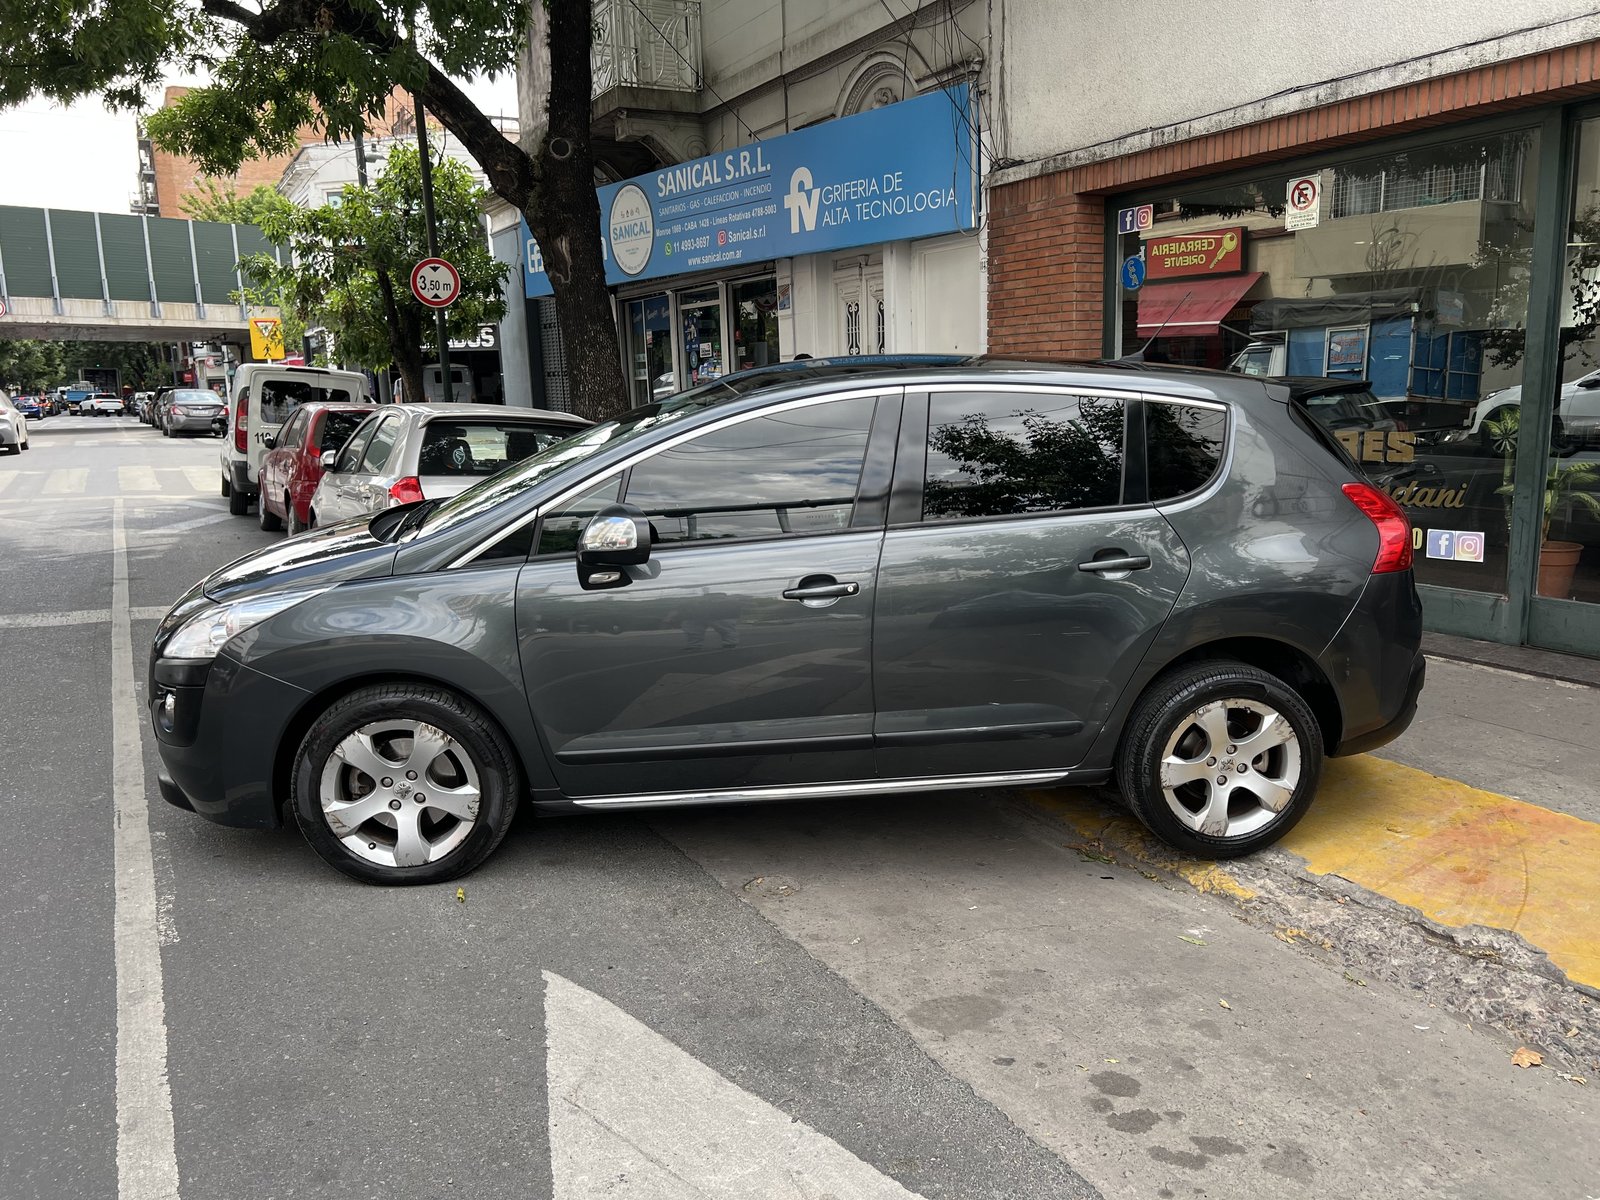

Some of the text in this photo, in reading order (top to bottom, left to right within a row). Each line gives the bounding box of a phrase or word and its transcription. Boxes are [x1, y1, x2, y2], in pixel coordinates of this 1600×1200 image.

[658, 147, 771, 197] SANICAL S.R.L.
[659, 202, 687, 217] SANITARIOS
[689, 199, 700, 210] GAS
[703, 190, 740, 206] CALEFACCION
[743, 182, 772, 196] INCENDIO
[821, 171, 903, 205] GRIFERIA DE
[822, 187, 958, 227] ALTA TECNOLOGIA
[612, 220, 651, 241] SANICAL
[656, 226, 671, 237] Monroe
[684, 221, 697, 231] CABA
[728, 210, 751, 222] Rotativas
[673, 242, 680, 253] 11
[687, 249, 743, 266] www.sanical.com.ar
[419, 275, 452, 292] 3,50 m
